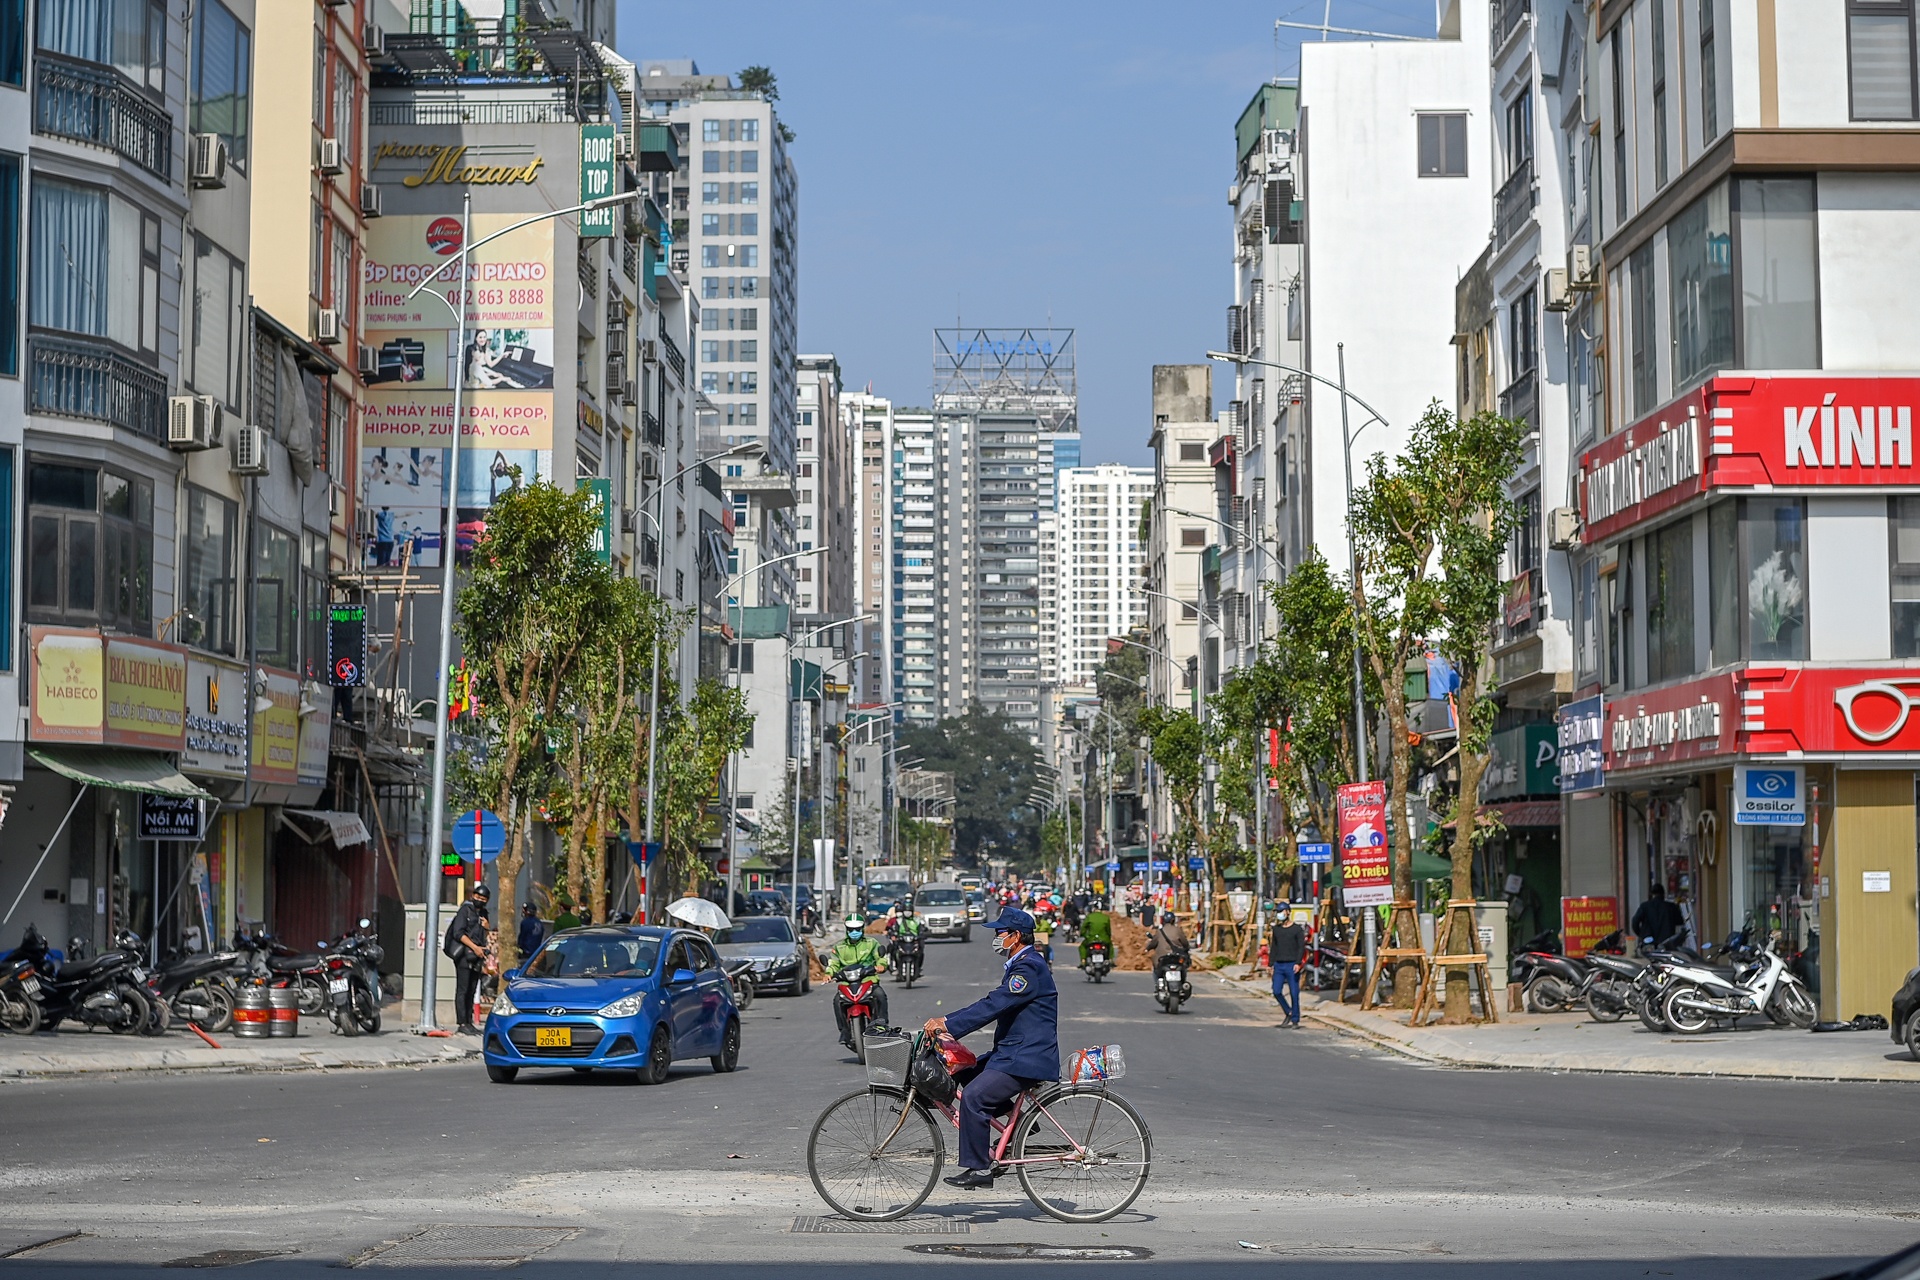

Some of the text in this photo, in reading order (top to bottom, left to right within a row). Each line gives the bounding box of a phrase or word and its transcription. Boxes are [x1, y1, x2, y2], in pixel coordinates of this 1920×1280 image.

[373, 140, 439, 170] piano
[584, 138, 612, 162] ROOF
[403, 145, 545, 188] Mozart
[587, 169, 608, 194] TOP
[365, 260, 388, 284] ỚP
[392, 263, 434, 286] HỌC
[484, 262, 546, 282] PIANO
[365, 290, 405, 306] otline:
[478, 289, 503, 305] 863
[509, 289, 544, 305] 8888
[469, 406, 498, 421] ĐẠI,
[503, 407, 547, 421] KPOP,
[365, 422, 424, 437] HIPHOP,
[490, 424, 530, 436] YOGA
[1784, 392, 1912, 468] KÍNH
[110, 656, 127, 684] BIA
[149, 657, 163, 690] HÀ
[164, 661, 182, 699] NỘI
[46, 685, 98, 700] HABECO
[109, 700, 120, 718] BIA
[1341, 793, 1383, 808] BLACK
[1746, 800, 1796, 811] essilor
[175, 813, 194, 826] Mi
[1343, 806, 1379, 821] Friday
[1343, 865, 1361, 879] 20
[1567, 910, 1614, 924] VÀNG BẠC
[546, 1029, 560, 1037] 30A
[540, 1037, 567, 1046] 209.16
